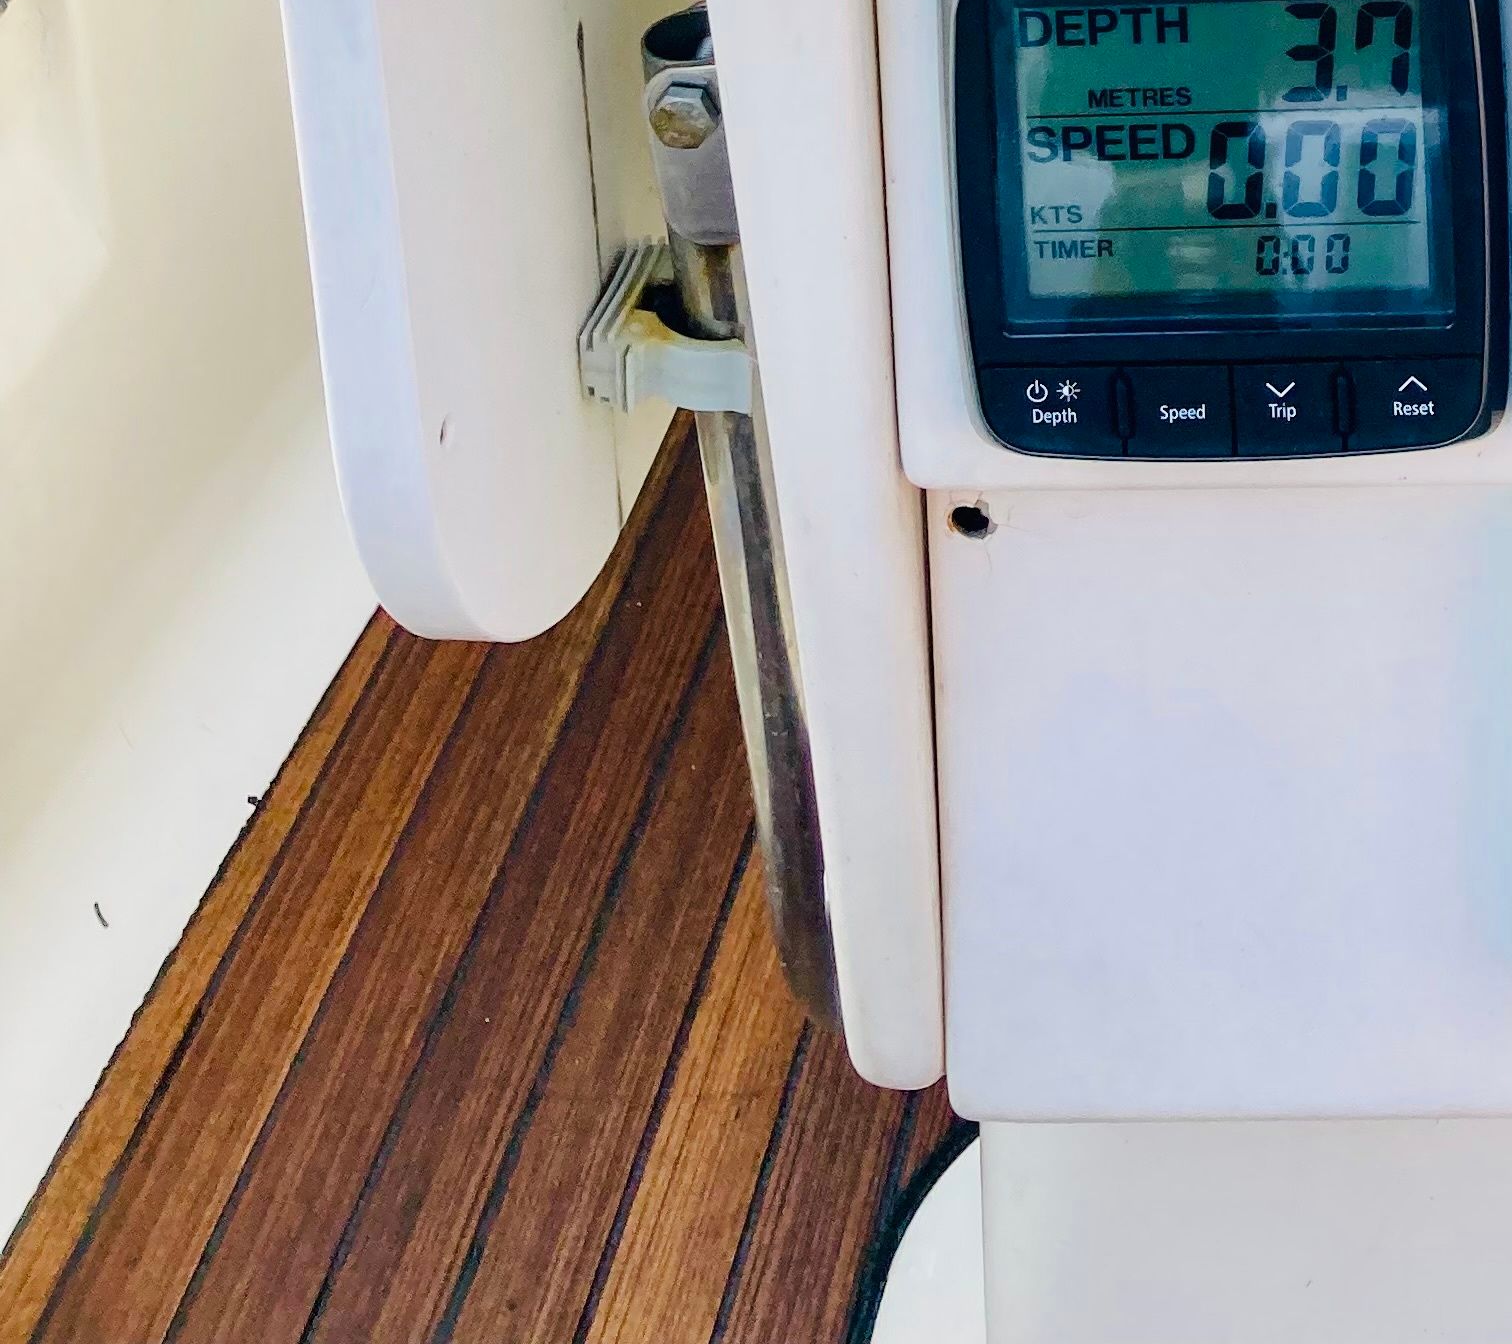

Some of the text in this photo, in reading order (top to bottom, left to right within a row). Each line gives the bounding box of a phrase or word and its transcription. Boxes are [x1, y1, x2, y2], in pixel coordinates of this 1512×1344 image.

[1018, 2, 1413, 102] DEPTH 3.7
[1088, 87, 1192, 110] METRES
[1028, 118, 1417, 220] SPEED 0.00
[1031, 205, 1083, 225] KTS
[1034, 239, 1114, 260] TIMER
[1032, 409, 1078, 425] Depth
[1160, 404, 1206, 421] Speed
[1268, 403, 1297, 421] Trip
[1393, 400, 1434, 417] Reset
